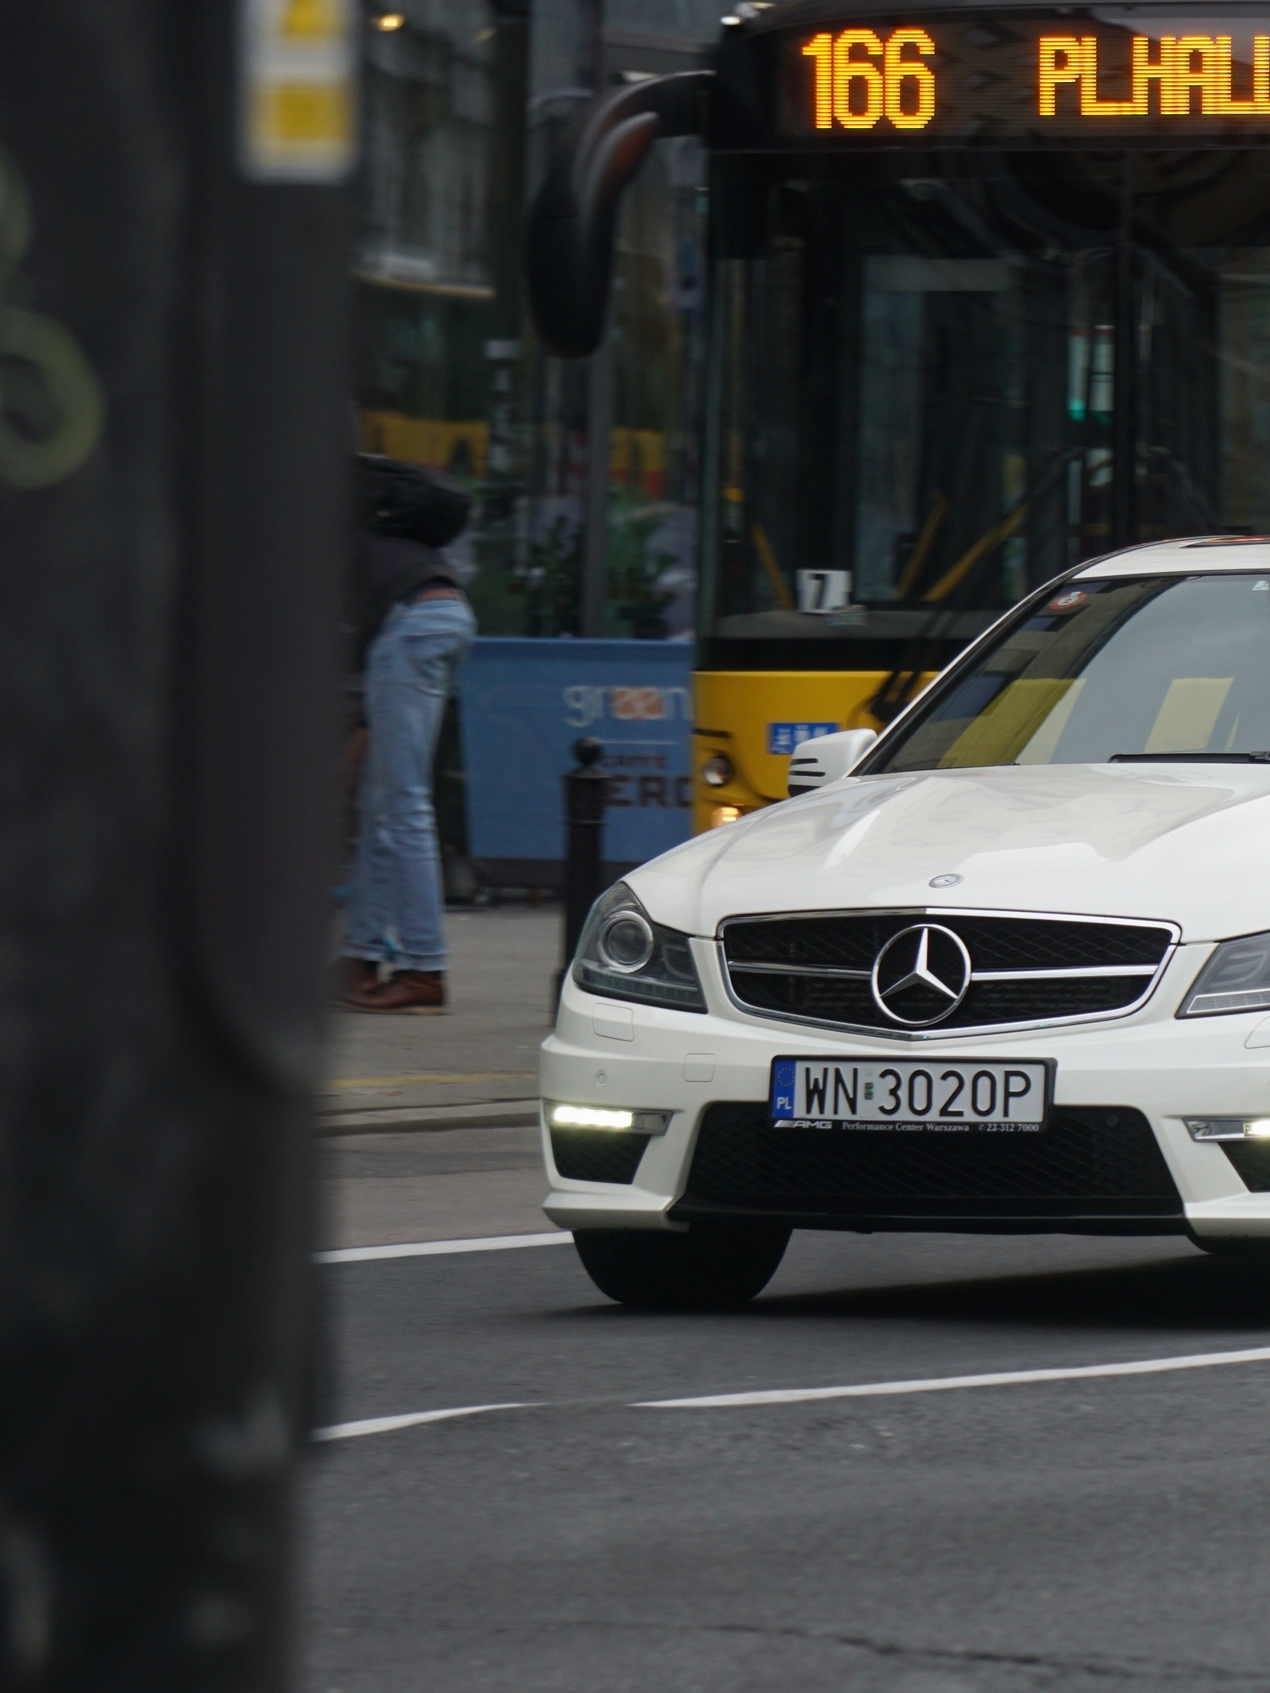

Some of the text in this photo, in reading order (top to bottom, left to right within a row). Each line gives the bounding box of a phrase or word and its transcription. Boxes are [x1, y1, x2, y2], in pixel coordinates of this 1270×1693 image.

[802, 29, 935, 129] 166
[776, 1096, 792, 1110] PL
[805, 1066, 1032, 1118] WN 3020P
[794, 1120, 833, 1130] AMG
[842, 1121, 893, 1131] Performance
[895, 1122, 925, 1131] Center
[926, 1122, 970, 1132] Warszawa
